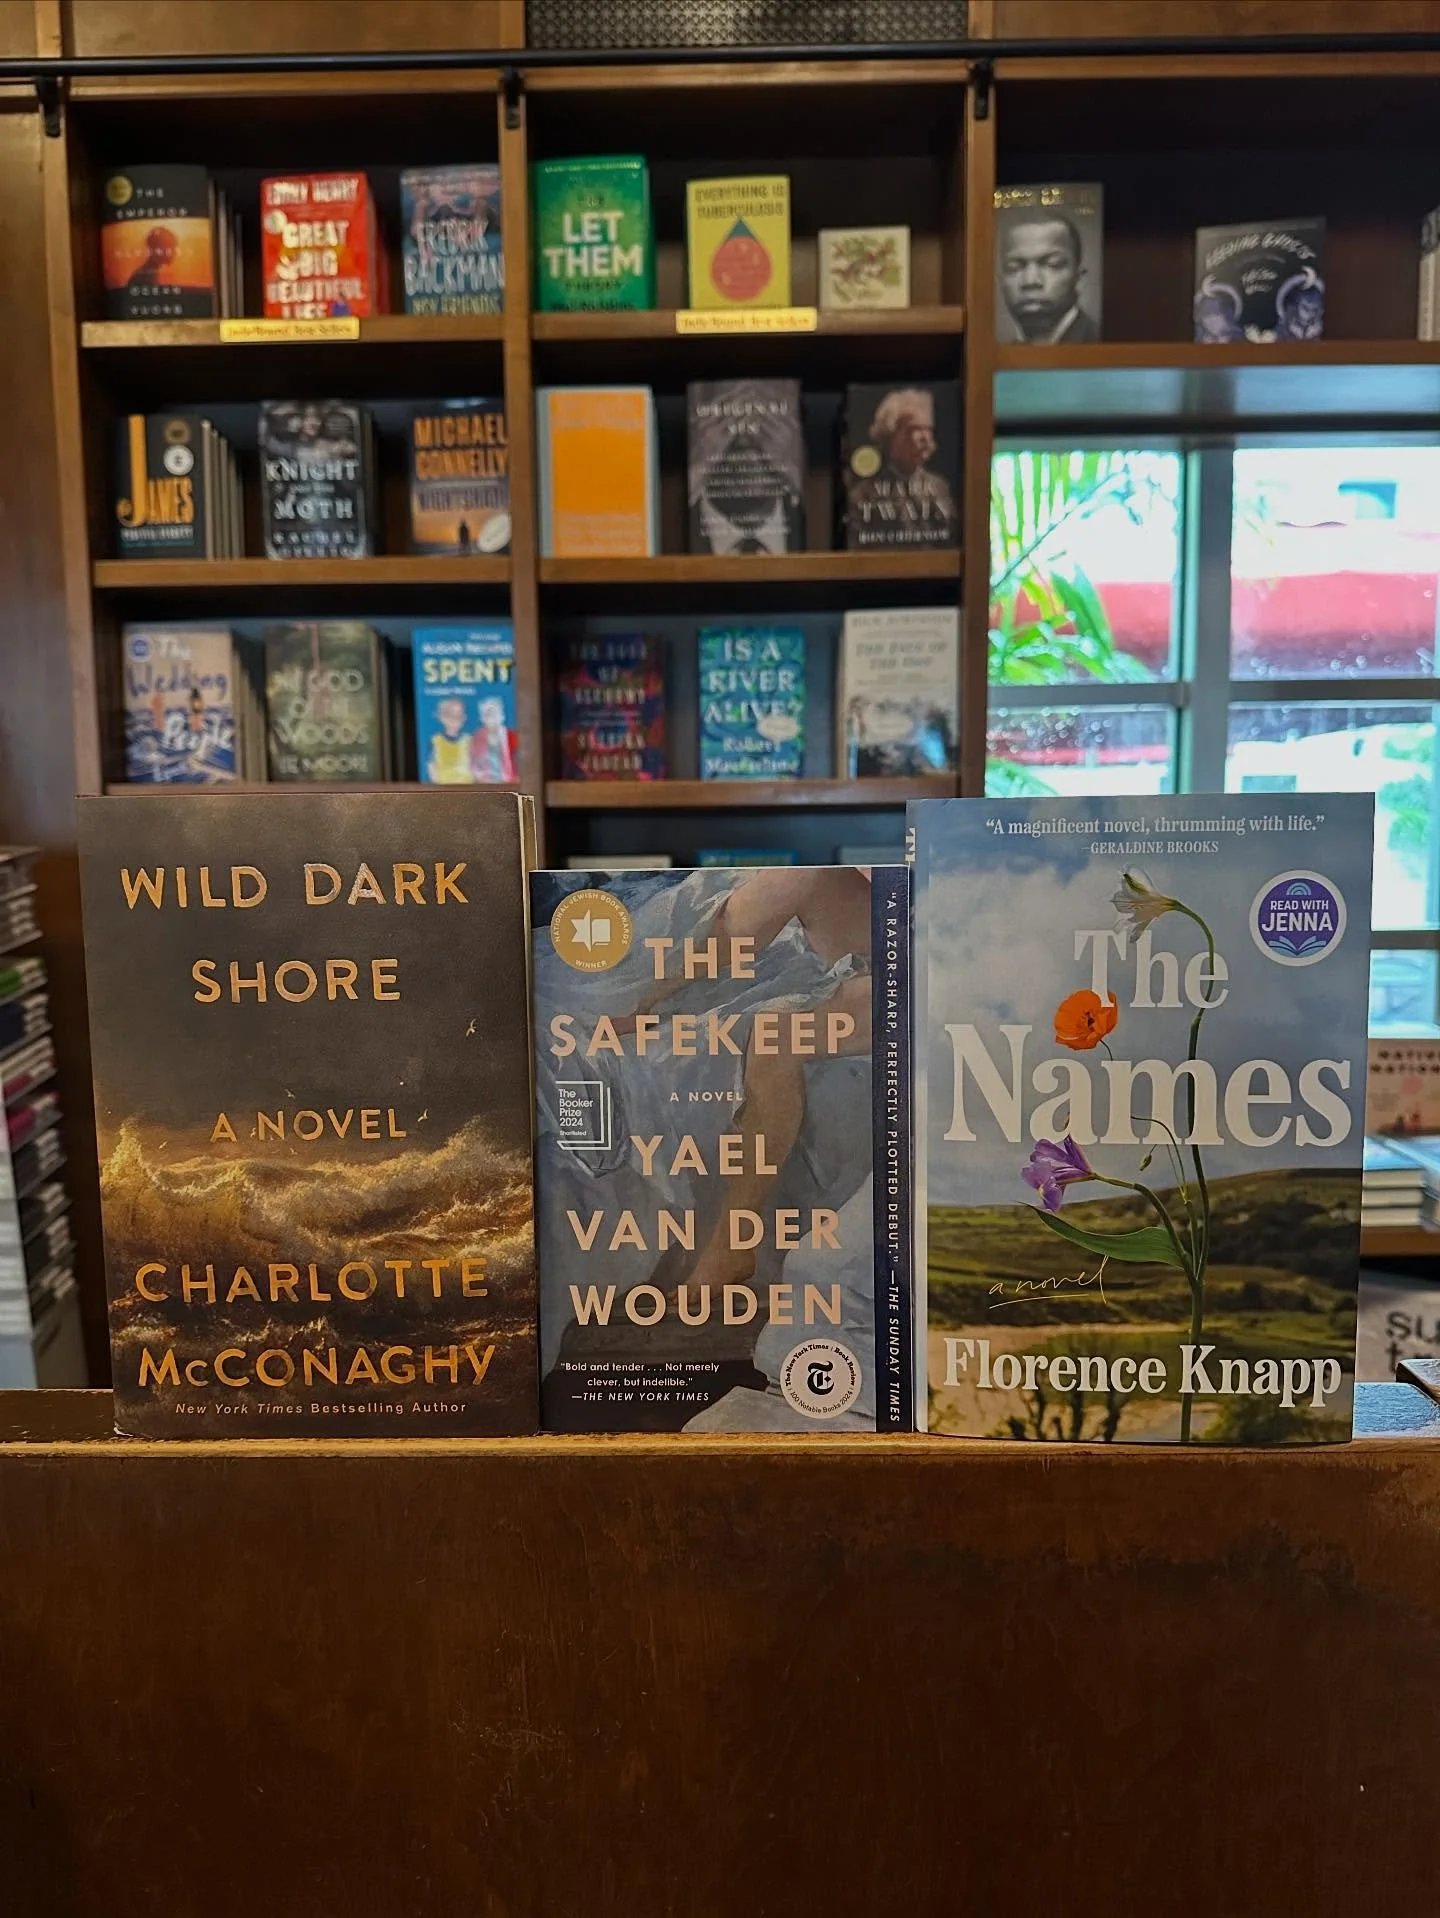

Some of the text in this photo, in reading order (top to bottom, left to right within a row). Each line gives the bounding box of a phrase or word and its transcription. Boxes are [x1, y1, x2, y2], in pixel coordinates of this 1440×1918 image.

[282, 220, 350, 248] GREAT
[562, 210, 624, 243] LET
[543, 244, 643, 278] THEM
[414, 413, 509, 447] MICHAEL
[265, 458, 360, 481] KNIGHT
[415, 449, 508, 481] CONNELLY
[724, 636, 782, 662] IS A
[422, 658, 513, 685] SPENT
[708, 669, 796, 693] RIVER
[1008, 818, 1100, 838] magnificent
[1104, 818, 1150, 835] novel,
[1151, 817, 1246, 836] thrumming
[1249, 816, 1284, 831] with
[1167, 841, 1219, 854] BROOKS
[120, 861, 470, 910] WILD DARK
[553, 904, 569, 942] NATIONAL
[569, 892, 598, 905] JEWISH
[600, 894, 620, 911] BOOK
[1270, 900, 1329, 910] READ WITH
[1261, 912, 1333, 932] JENNA
[575, 959, 608, 969] WINNER
[644, 936, 756, 980] THE
[1074, 929, 1230, 1010] The
[191, 958, 402, 1004] SHORE
[885, 918, 897, 1034] RAZOR-SHARP,
[549, 1012, 856, 1057] SAFEKEEP
[558, 1089, 577, 1098] The
[669, 1090, 743, 1102] A NOVEL
[887, 1042, 898, 1122] PERFECTLY
[943, 1023, 1353, 1148] Names
[559, 1098, 594, 1108] Booker
[559, 1108, 582, 1117] Prize
[210, 1107, 408, 1143] A NOVEL
[559, 1117, 584, 1127] 2024
[630, 1134, 778, 1177] YAEL
[887, 1131, 898, 1195] PLOTTED
[566, 1208, 842, 1251] VAN DER
[135, 1257, 489, 1304] CHARLOTTE
[988, 1255, 1109, 1305] a novel
[569, 1284, 842, 1326] WOUDEN
[834, 1347, 849, 1362] Book
[888, 1318, 900, 1375] SUNDAY
[138, 1344, 497, 1387] McCONAGHY
[590, 1362, 610, 1372] and
[612, 1362, 645, 1372] tender
[665, 1362, 683, 1372] Not
[685, 1363, 720, 1374] merely
[943, 1337, 1167, 1394] Florence
[1178, 1344, 1342, 1409] Knapp
[587, 1378, 621, 1388] clever,
[624, 1378, 640, 1387] but
[608, 1392, 634, 1401] NEW
[639, 1392, 670, 1401] YORK
[675, 1392, 709, 1401] TIMES
[176, 1401, 467, 1416] New York Times Bestselling Author
[798, 1401, 821, 1414] Notable
[822, 1404, 841, 1413] Books
[839, 1390, 853, 1405] 2024
[889, 1382, 901, 1422] TIMES
